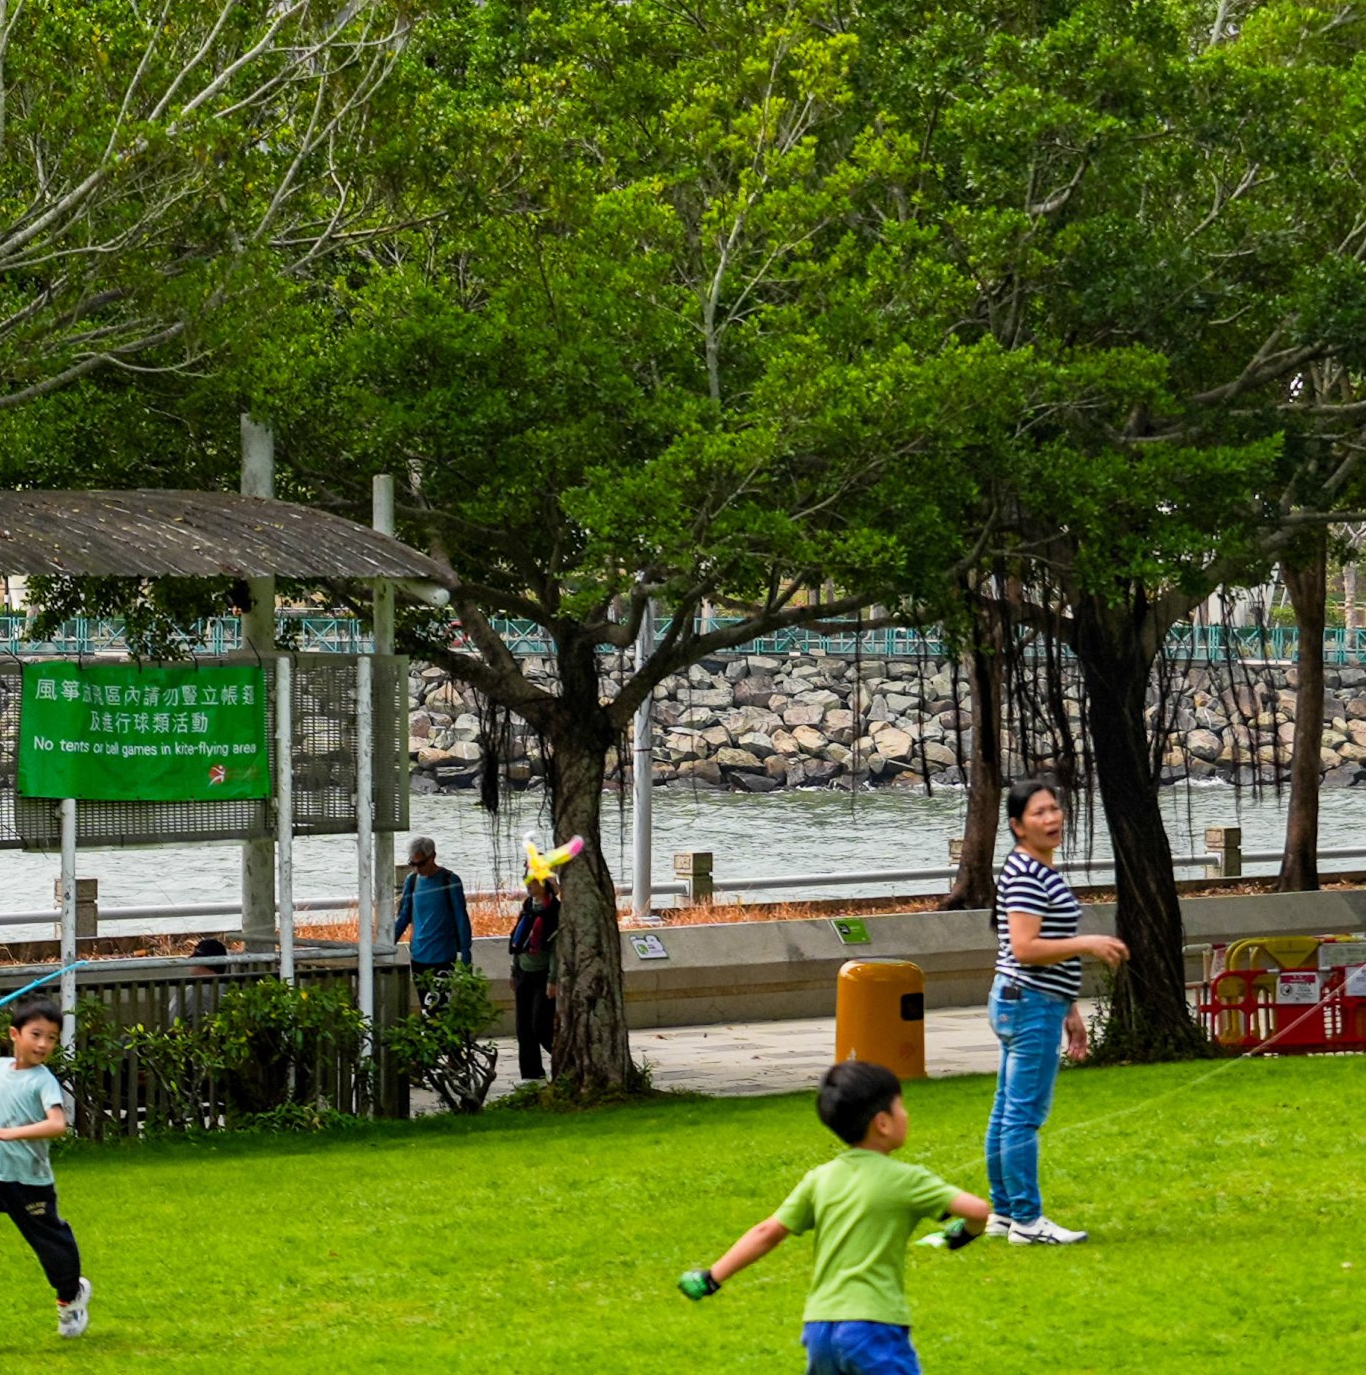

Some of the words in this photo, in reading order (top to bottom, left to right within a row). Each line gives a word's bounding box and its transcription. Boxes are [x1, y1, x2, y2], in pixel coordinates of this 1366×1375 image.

[89, 710, 208, 734] 及進行球類活動
[34, 736, 54, 751] No
[60, 739, 90, 753] tents
[93, 742, 103, 754] or
[105, 741, 120, 755] ball
[122, 743, 157, 758] games
[161, 742, 171, 755] in
[175, 741, 229, 757] kite-flying
[233, 744, 256, 754] area
